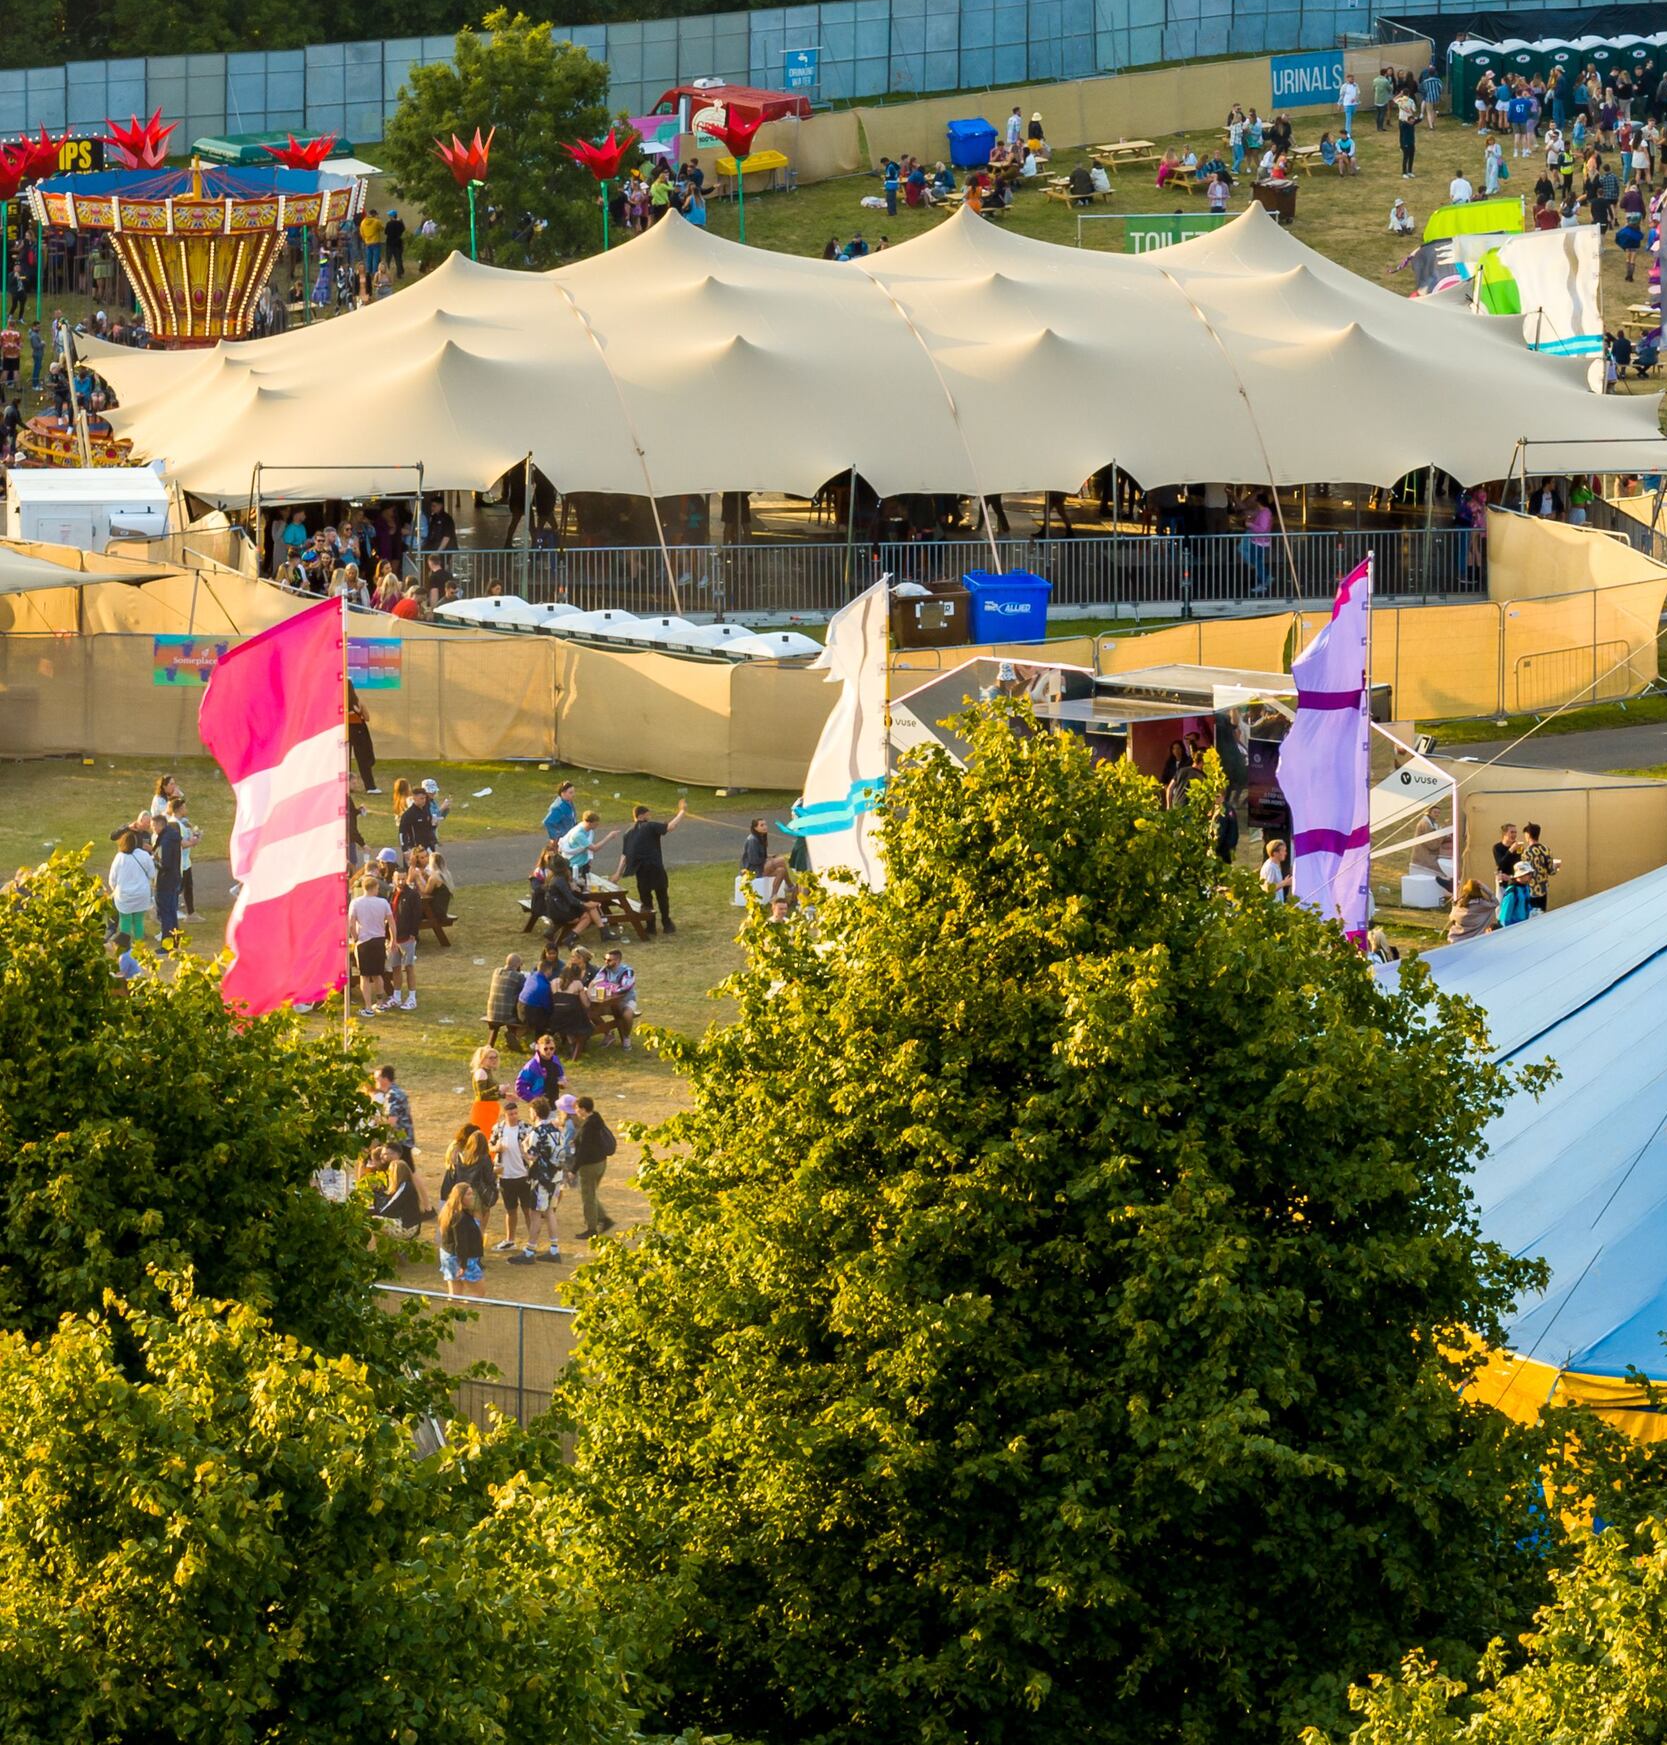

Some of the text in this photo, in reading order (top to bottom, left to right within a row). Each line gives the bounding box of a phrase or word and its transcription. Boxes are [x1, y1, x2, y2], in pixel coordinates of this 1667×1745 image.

[1273, 64, 1342, 95] URINALS
[1516, 104, 1524, 113] 67
[173, 656, 218, 666] Someplace
